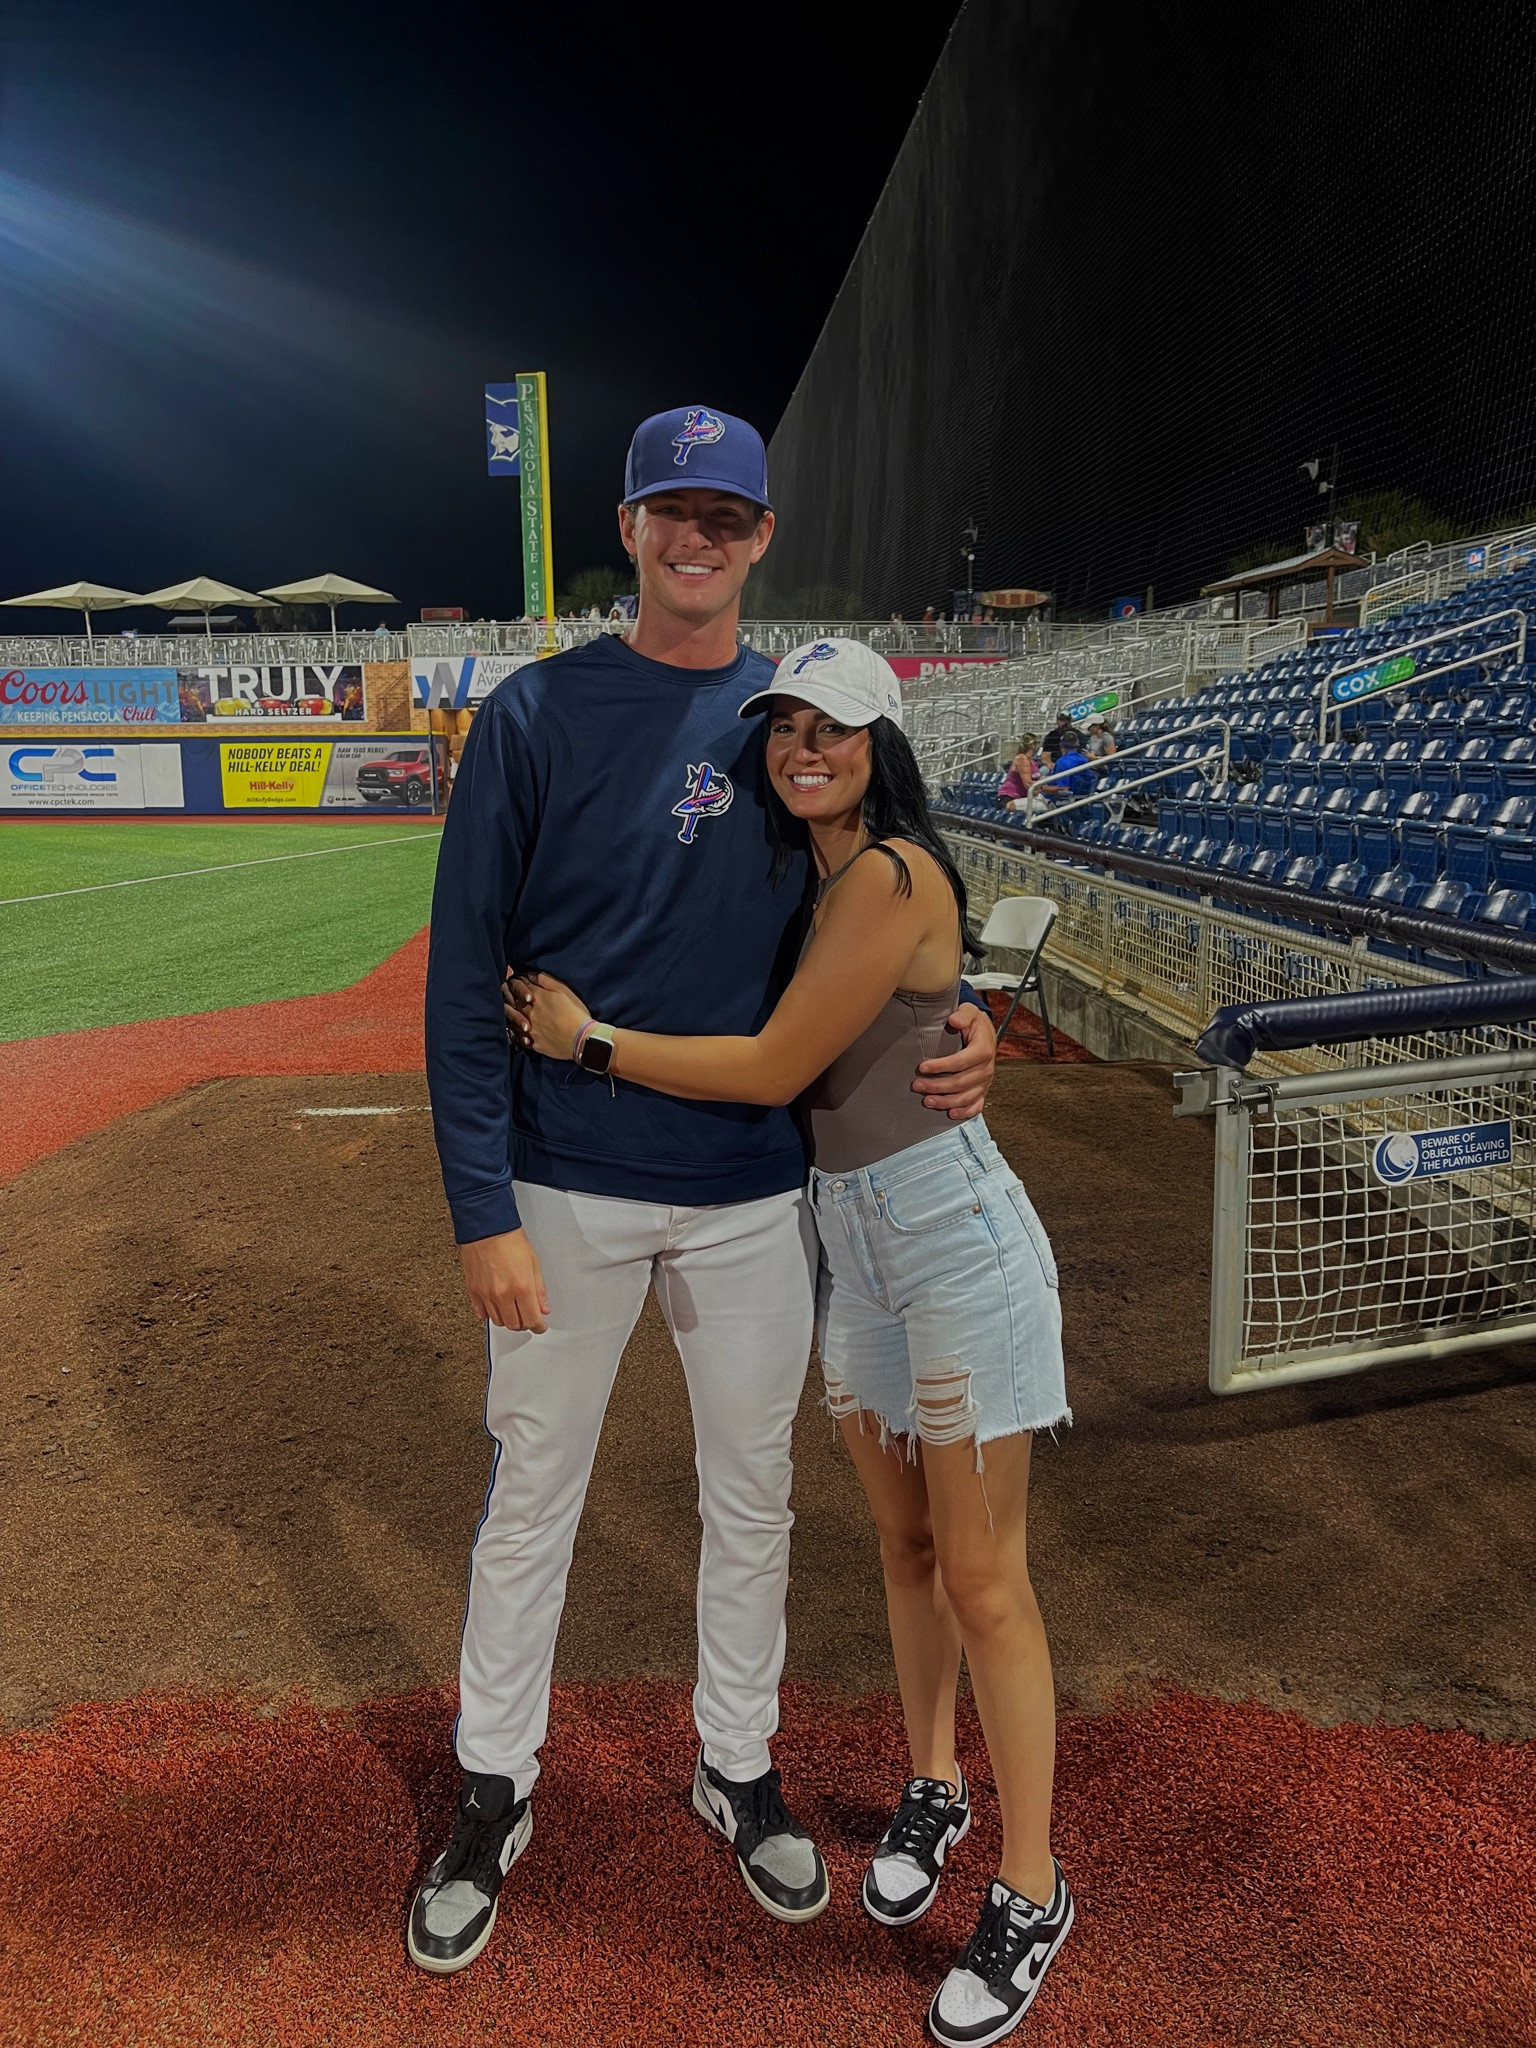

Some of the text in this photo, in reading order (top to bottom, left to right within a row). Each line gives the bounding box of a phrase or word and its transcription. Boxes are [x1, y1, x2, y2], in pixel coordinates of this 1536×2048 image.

[481, 660, 524, 673] Warre
[0, 669, 175, 705] Coors LIGHT
[198, 666, 344, 704] TRULY
[1337, 671, 1379, 697] COX
[17, 705, 158, 722] KEEPING PENSACOLA Chill
[235, 708, 312, 716] HARD SELTZER
[1071, 702, 1097, 719] COX
[228, 748, 322, 760] NOBODY BEATS A
[9, 748, 117, 782] CPC
[228, 761, 321, 772] HILL-KELLY DEAL!
[249, 781, 295, 792] Hill-Kelly
[28, 798, 95, 806] www.cpctek.com
[1421, 1132, 1476, 1148] BEWARE OF
[1421, 1139, 1505, 1160] OBJECTS LEAVING
[1421, 1160, 1441, 1171] THE
[1443, 1153, 1482, 1169] PLAYING
